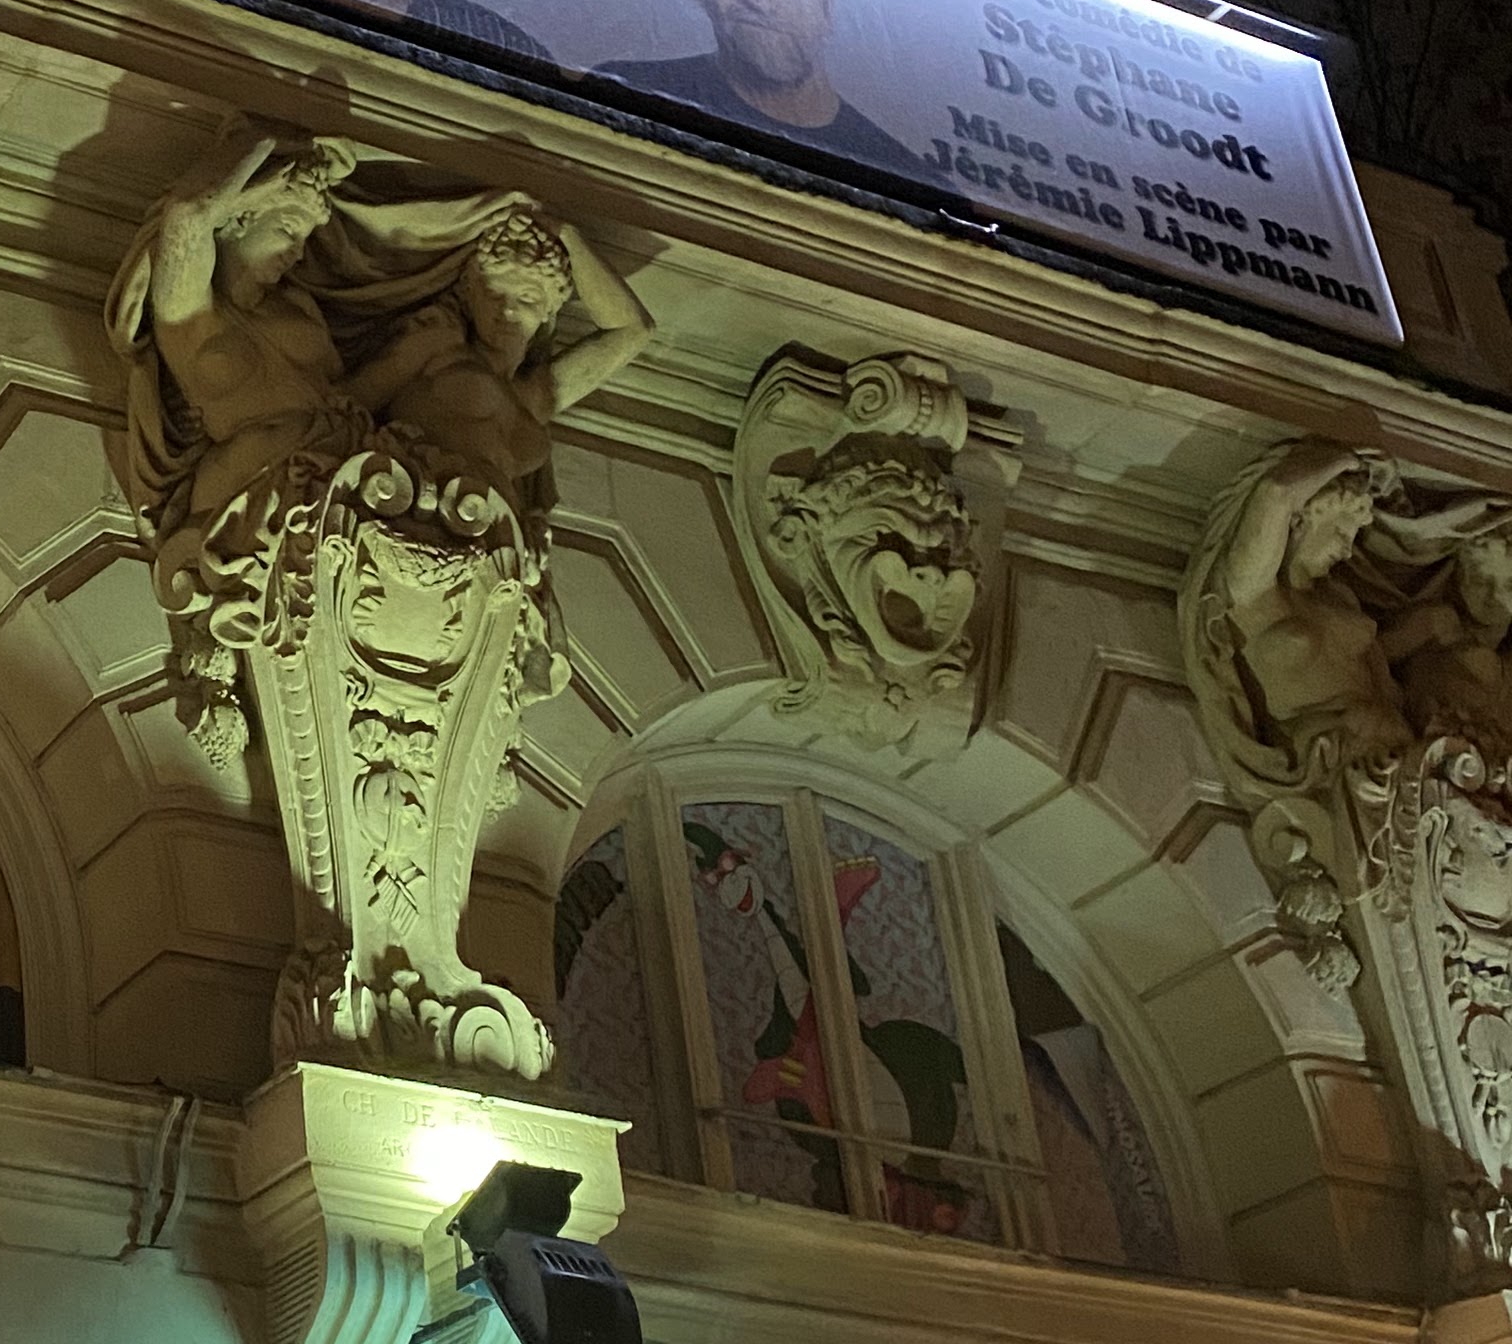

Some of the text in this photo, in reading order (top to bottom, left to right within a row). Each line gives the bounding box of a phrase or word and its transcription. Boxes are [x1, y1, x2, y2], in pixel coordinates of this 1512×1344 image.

[978, 49, 1275, 183] De Groodt
[982, 2, 1243, 123] Stéphane
[1215, 44, 1264, 83] de
[923, 138, 1380, 316] Jérémie Lippmann
[946, 104, 1333, 261] Mise en scène par
